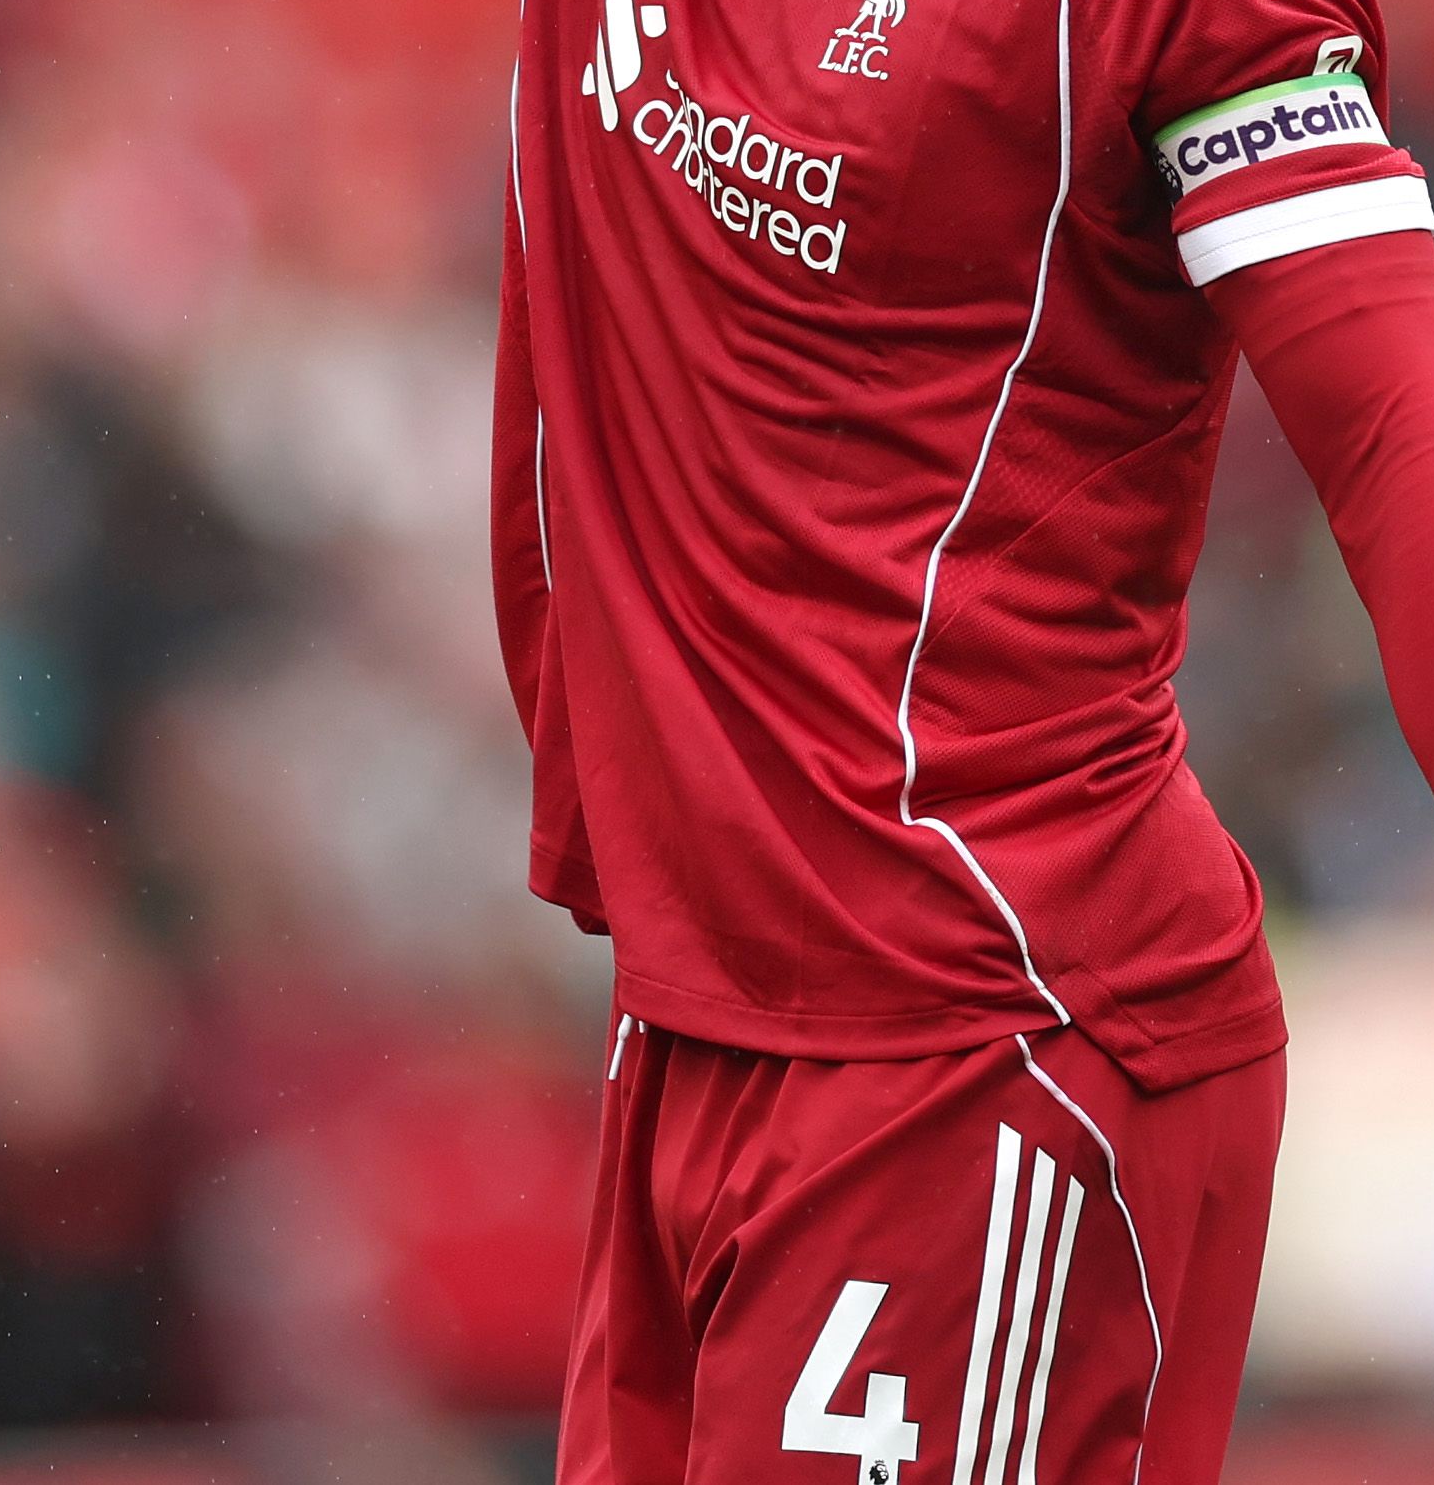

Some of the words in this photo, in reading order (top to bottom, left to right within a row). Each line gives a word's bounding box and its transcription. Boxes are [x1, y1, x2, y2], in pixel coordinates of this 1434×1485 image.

[817, 38, 889, 81] L.F.C.
[666, 69, 843, 209] ndard
[781, 1280, 919, 1485] 4
